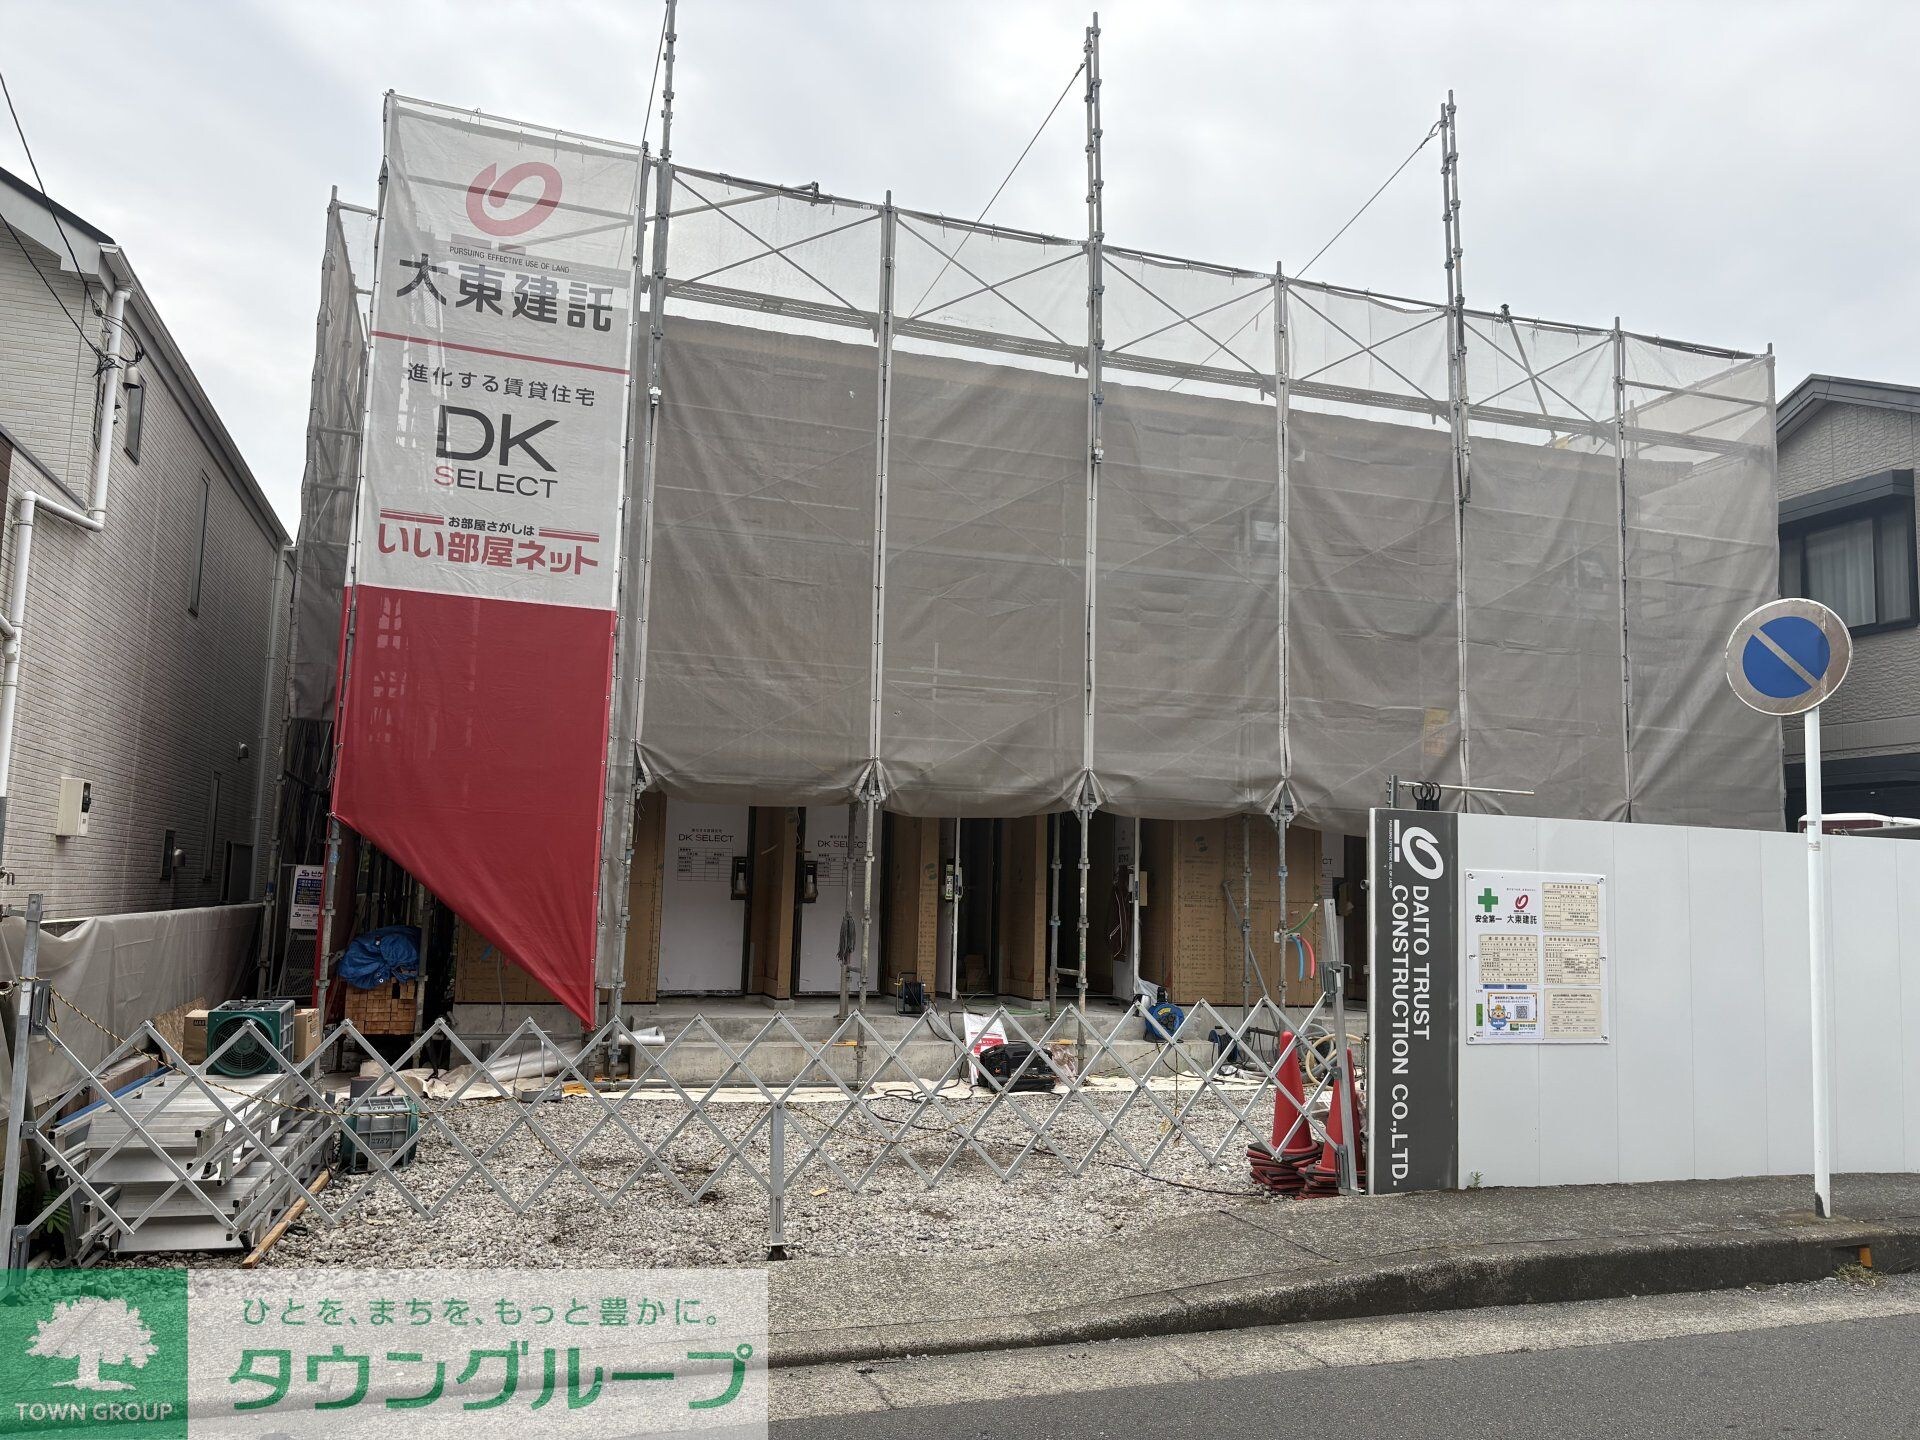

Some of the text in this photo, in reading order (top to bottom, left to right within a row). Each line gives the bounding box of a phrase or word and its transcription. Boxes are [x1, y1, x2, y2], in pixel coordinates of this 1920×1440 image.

[449, 246, 570, 273] PURSUING EFFECTIVE USE OF LAND
[396, 253, 613, 333] 大東建託
[407, 362, 596, 407] 進化する賃貸住宅
[435, 404, 560, 472] DK
[434, 465, 558, 498] SELECT
[448, 515, 535, 537] お部屋さがしは
[379, 523, 598, 575] いい部屋ネット
[678, 833, 734, 843] DK SELECT
[1475, 915, 1503, 924] 安全第一
[1507, 915, 1538, 925] 大東建託
[1391, 885, 1409, 1076] CONSTRUCTION
[1412, 886, 1430, 1040] DAITO TRUST
